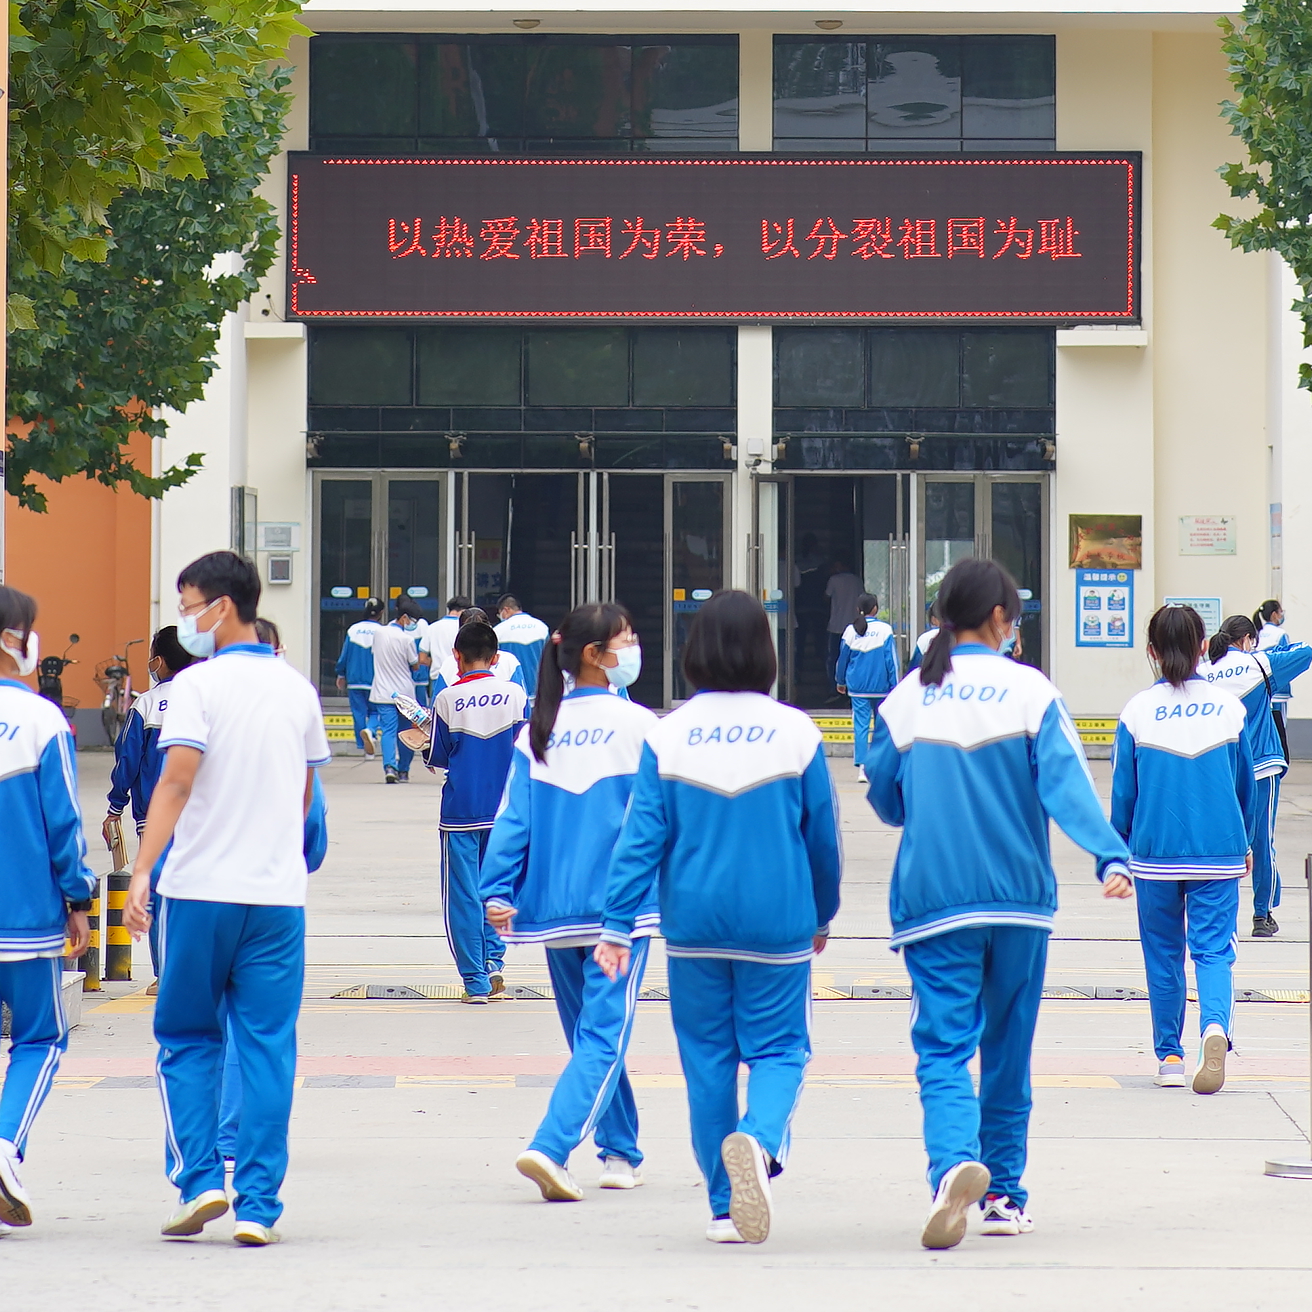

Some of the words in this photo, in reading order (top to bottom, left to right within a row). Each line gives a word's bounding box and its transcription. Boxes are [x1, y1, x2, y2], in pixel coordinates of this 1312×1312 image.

[1207, 665, 1250, 683] BAODI
[454, 693, 510, 712] BAODI
[922, 683, 1009, 707] BAODI
[1155, 702, 1224, 721] BAODI
[688, 725, 776, 746] BAODI
